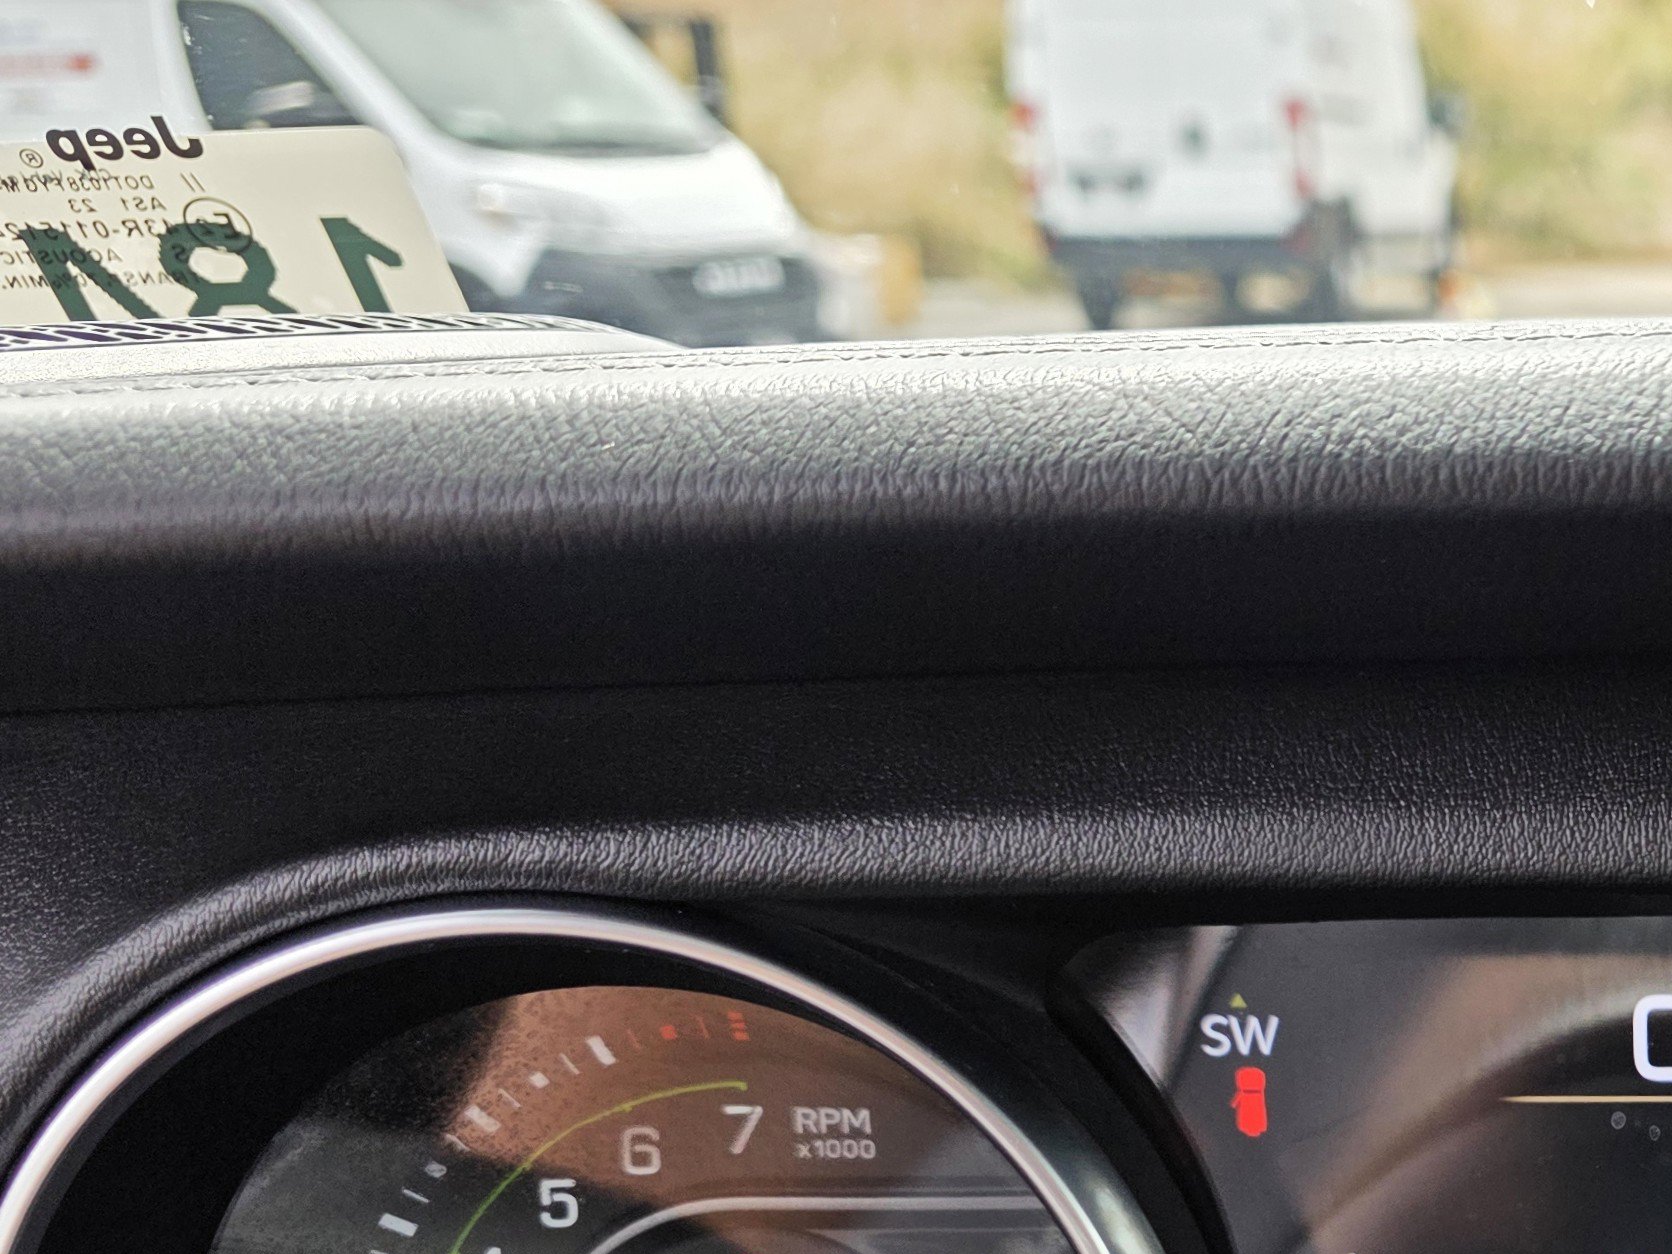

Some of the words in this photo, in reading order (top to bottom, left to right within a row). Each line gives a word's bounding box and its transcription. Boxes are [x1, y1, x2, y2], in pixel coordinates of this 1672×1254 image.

[1200, 1013, 1280, 1057] SW
[722, 1105, 764, 1155] 7
[792, 1106, 872, 1135] RPM
[620, 1126, 662, 1176] 6
[795, 1138, 876, 1160] x1000
[539, 1178, 580, 1229] 5
